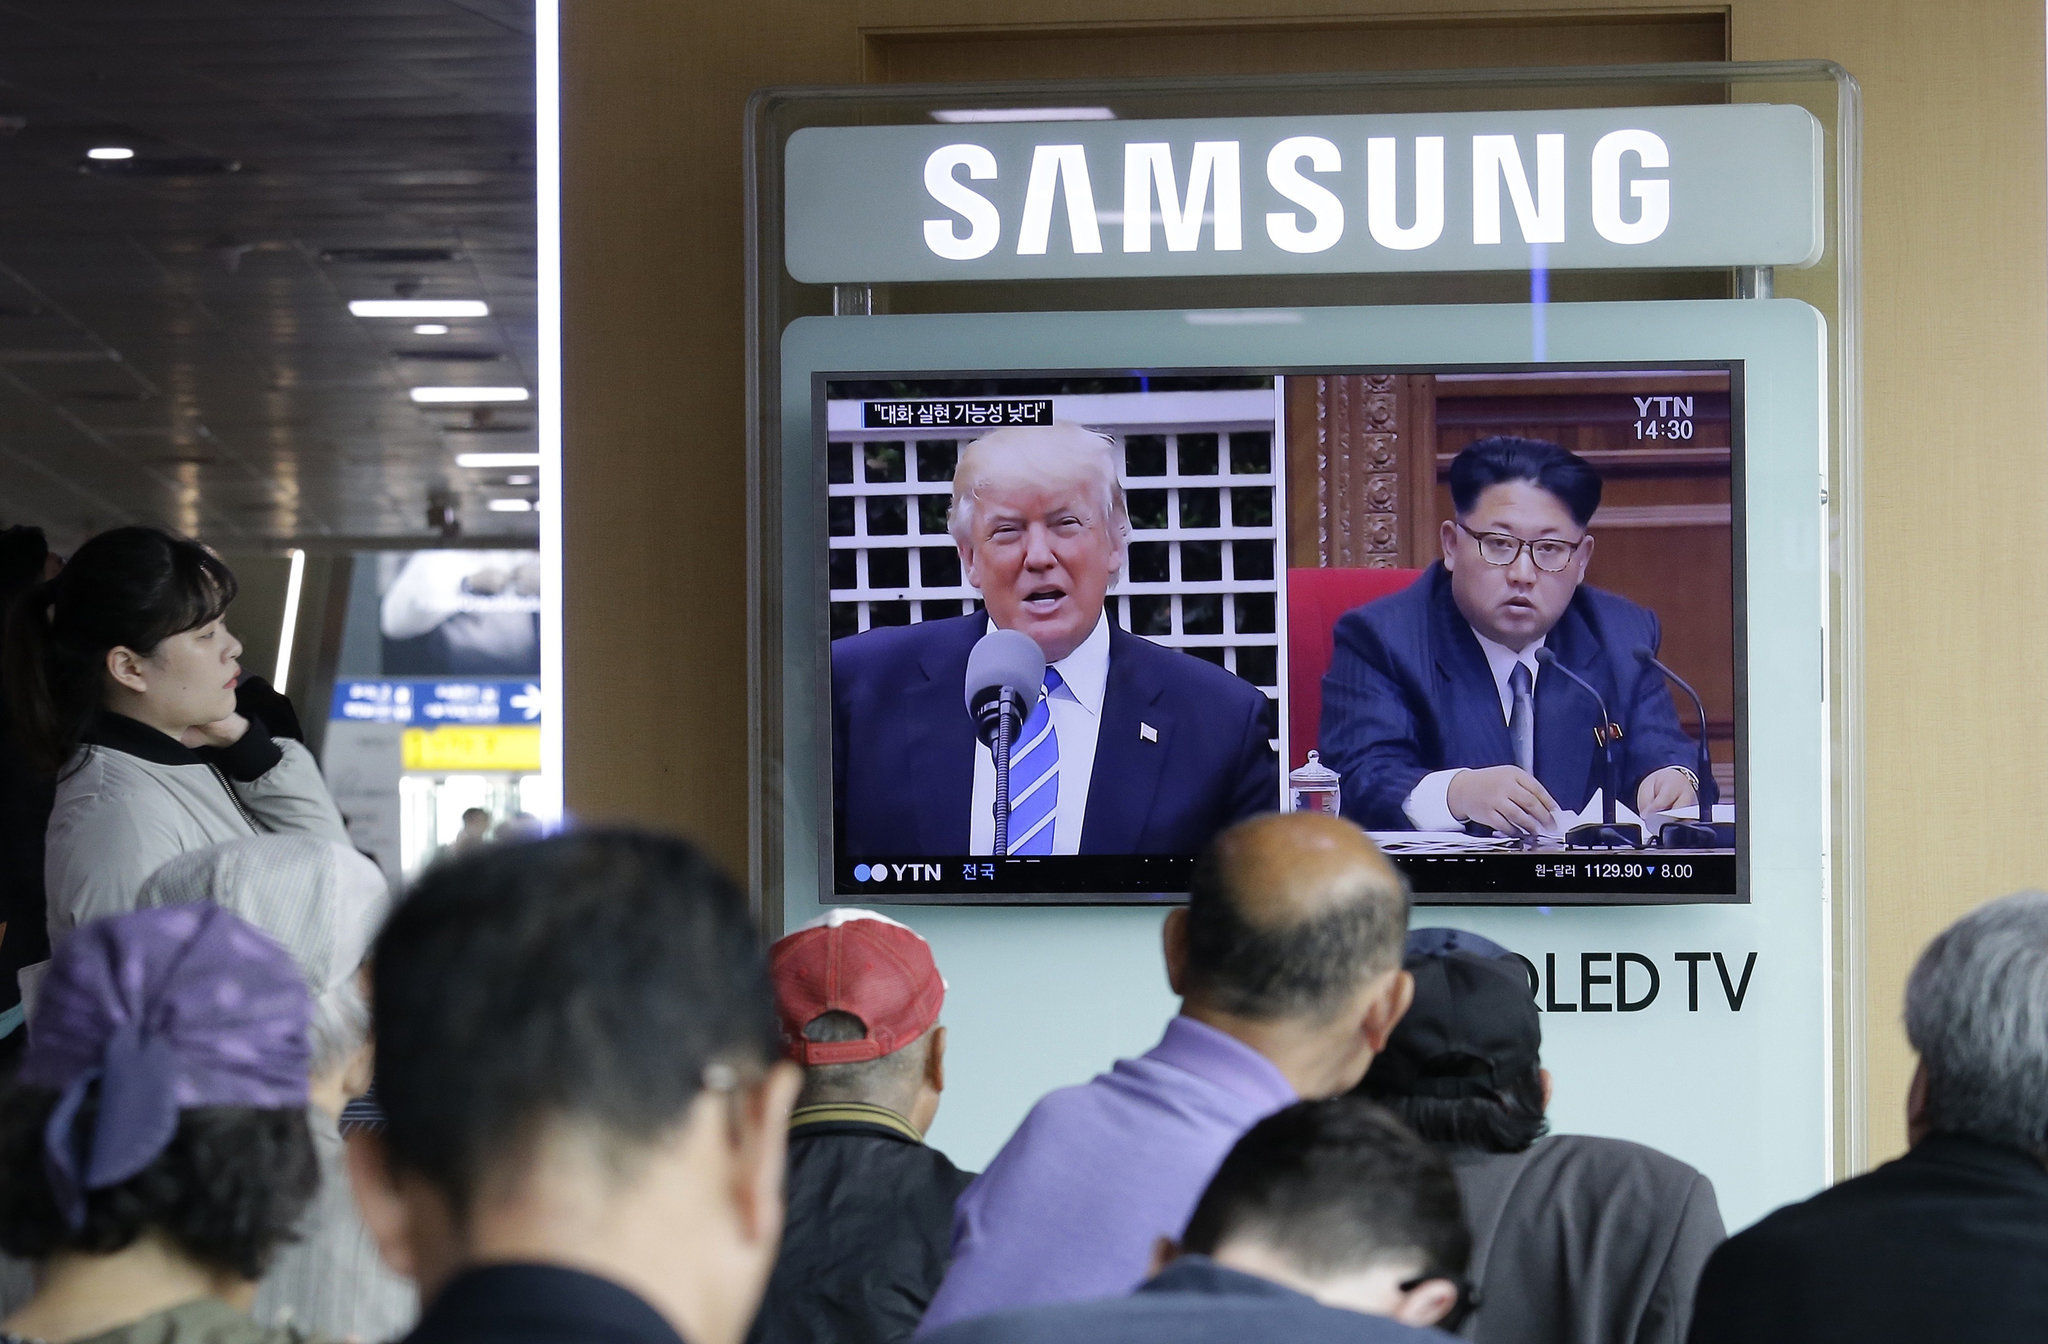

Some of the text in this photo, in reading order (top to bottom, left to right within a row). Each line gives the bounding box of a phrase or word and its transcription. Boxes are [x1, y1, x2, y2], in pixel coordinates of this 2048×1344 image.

[922, 129, 1671, 260] SAMSUNG
[874, 402, 1046, 424] "대화 실현 가능성 낮다"
[1633, 396, 1693, 417] YTN
[1633, 420, 1693, 440] 14:30
[891, 863, 942, 882] YTN
[962, 863, 995, 881] 전국
[1534, 863, 1693, 878] 원-달러 1129.90 8.00
[1674, 952, 1758, 1012] TV
